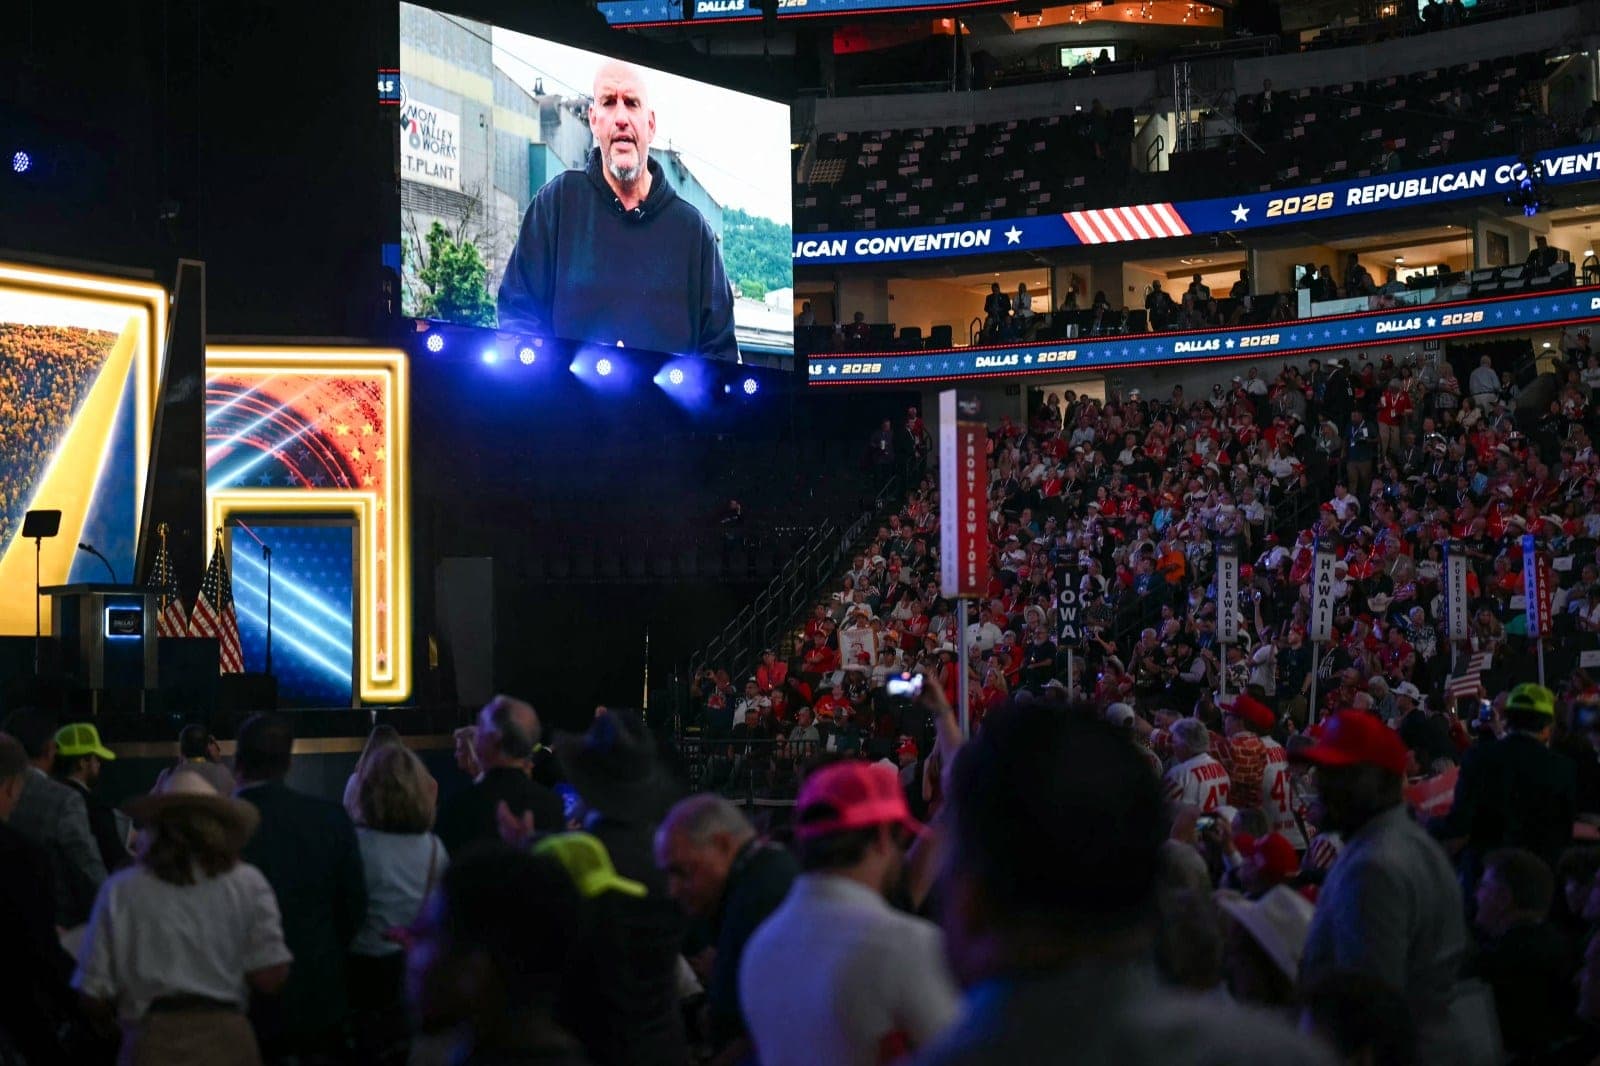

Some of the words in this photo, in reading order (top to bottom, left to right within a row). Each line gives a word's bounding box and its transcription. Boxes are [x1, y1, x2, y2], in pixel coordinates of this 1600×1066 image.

[697, 0, 745, 13] DALLAS
[407, 105, 437, 125] MON
[420, 123, 453, 143] VALLEY
[423, 139, 457, 160] WORKS
[1266, 192, 1333, 218] 2026
[1346, 168, 1486, 207] REPUBLICAN
[855, 229, 991, 256] CONVENTION
[1375, 317, 1421, 333] DALLAS
[1174, 338, 1220, 353] DALLAS
[975, 354, 1019, 368] DALLAS
[967, 537, 977, 587] JOES
[1060, 572, 1077, 639] IOWA
[1224, 561, 1233, 637] DELAWARE
[1318, 559, 1331, 635] HAWAII
[1527, 558, 1536, 633] ALABAMA
[1538, 556, 1549, 633] ALABAMA
